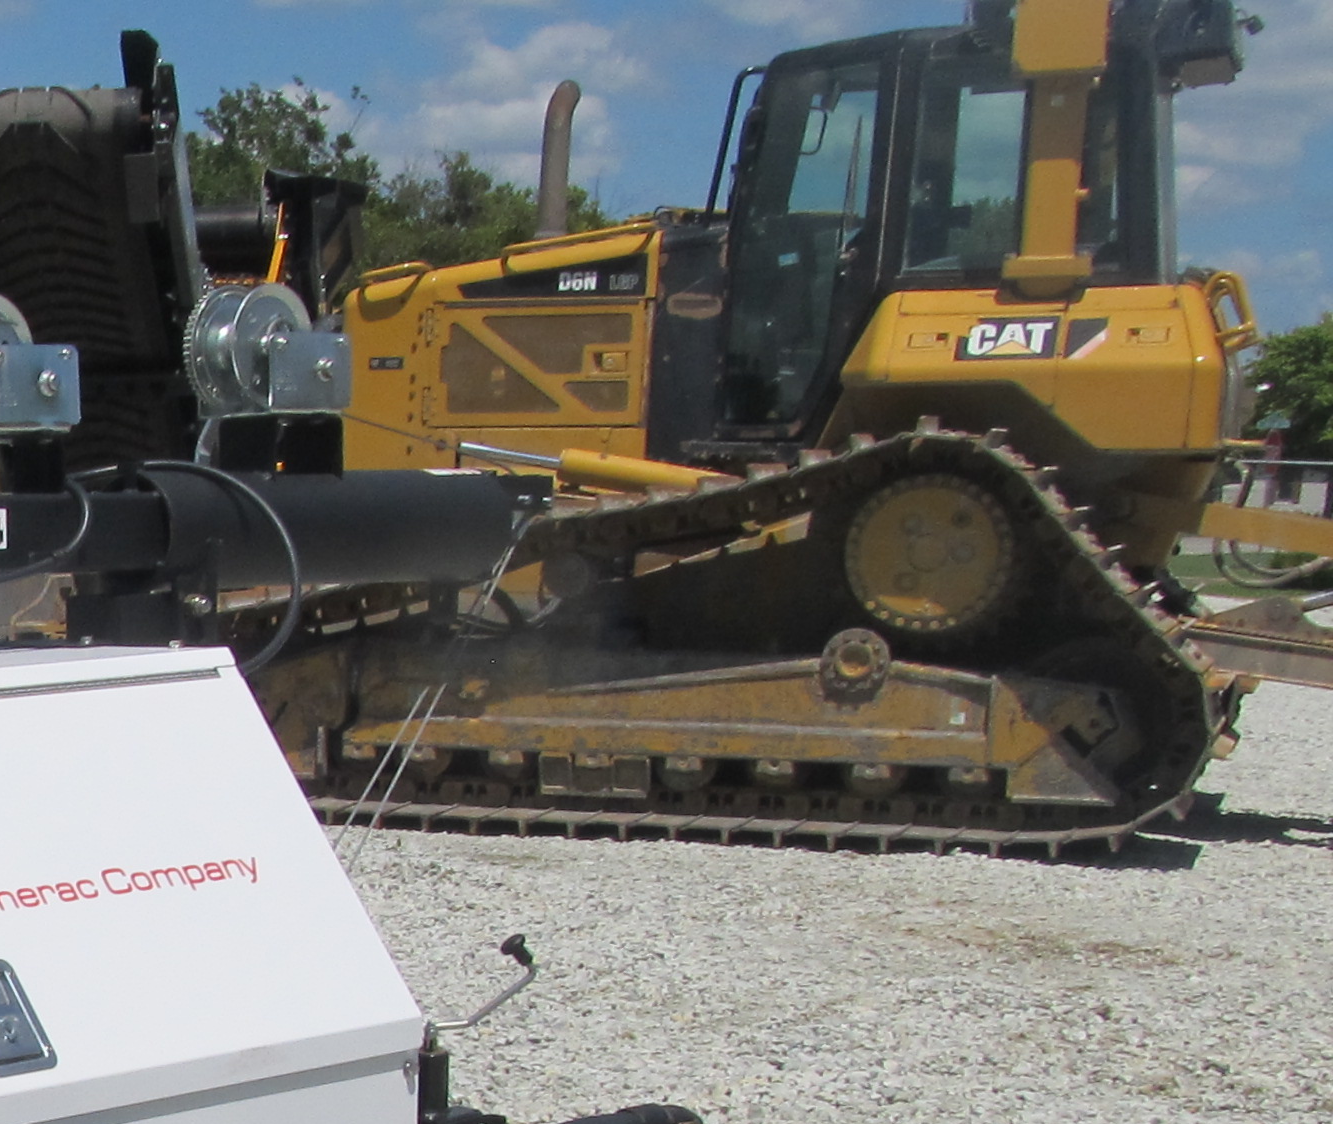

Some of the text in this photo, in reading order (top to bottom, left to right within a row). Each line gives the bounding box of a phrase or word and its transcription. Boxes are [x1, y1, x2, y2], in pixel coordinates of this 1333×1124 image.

[557, 271, 598, 292] D6N
[966, 321, 1055, 356] CAT
[100, 856, 259, 895] Company
